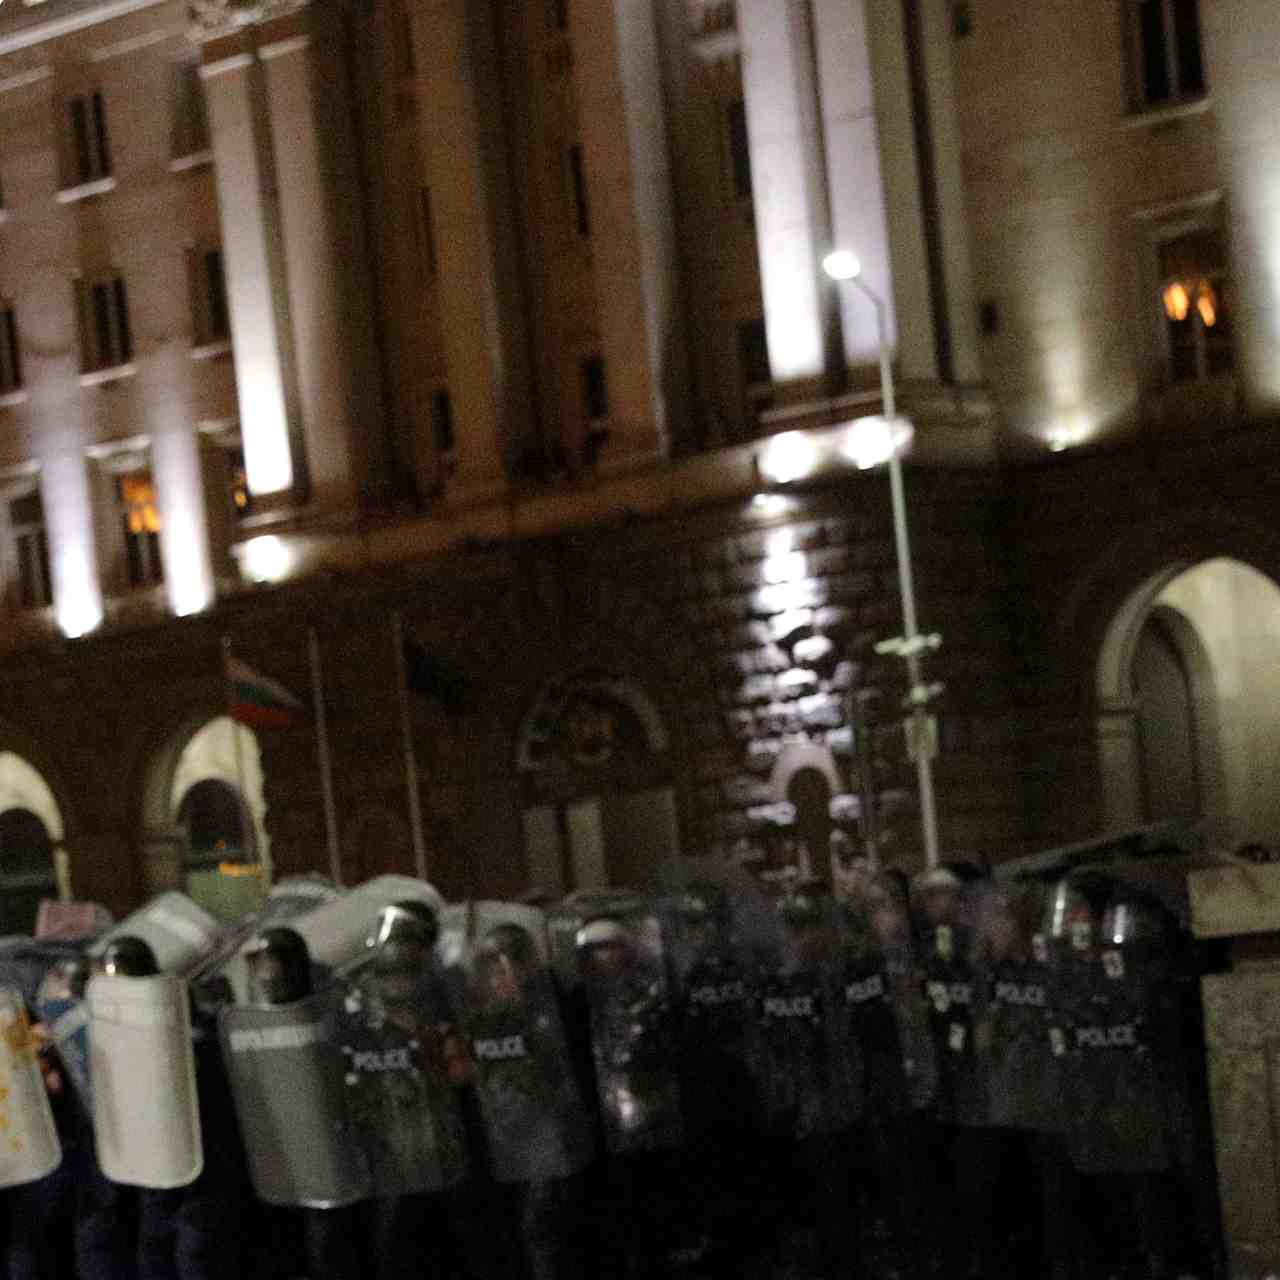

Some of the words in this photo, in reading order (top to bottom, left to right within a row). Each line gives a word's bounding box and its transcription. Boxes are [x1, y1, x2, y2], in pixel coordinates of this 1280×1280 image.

[995, 981, 1046, 1007] POLICE
[474, 1035, 526, 1059] POLICE
[1076, 1023, 1136, 1047] POLICE
[353, 1047, 410, 1072] POLICE
